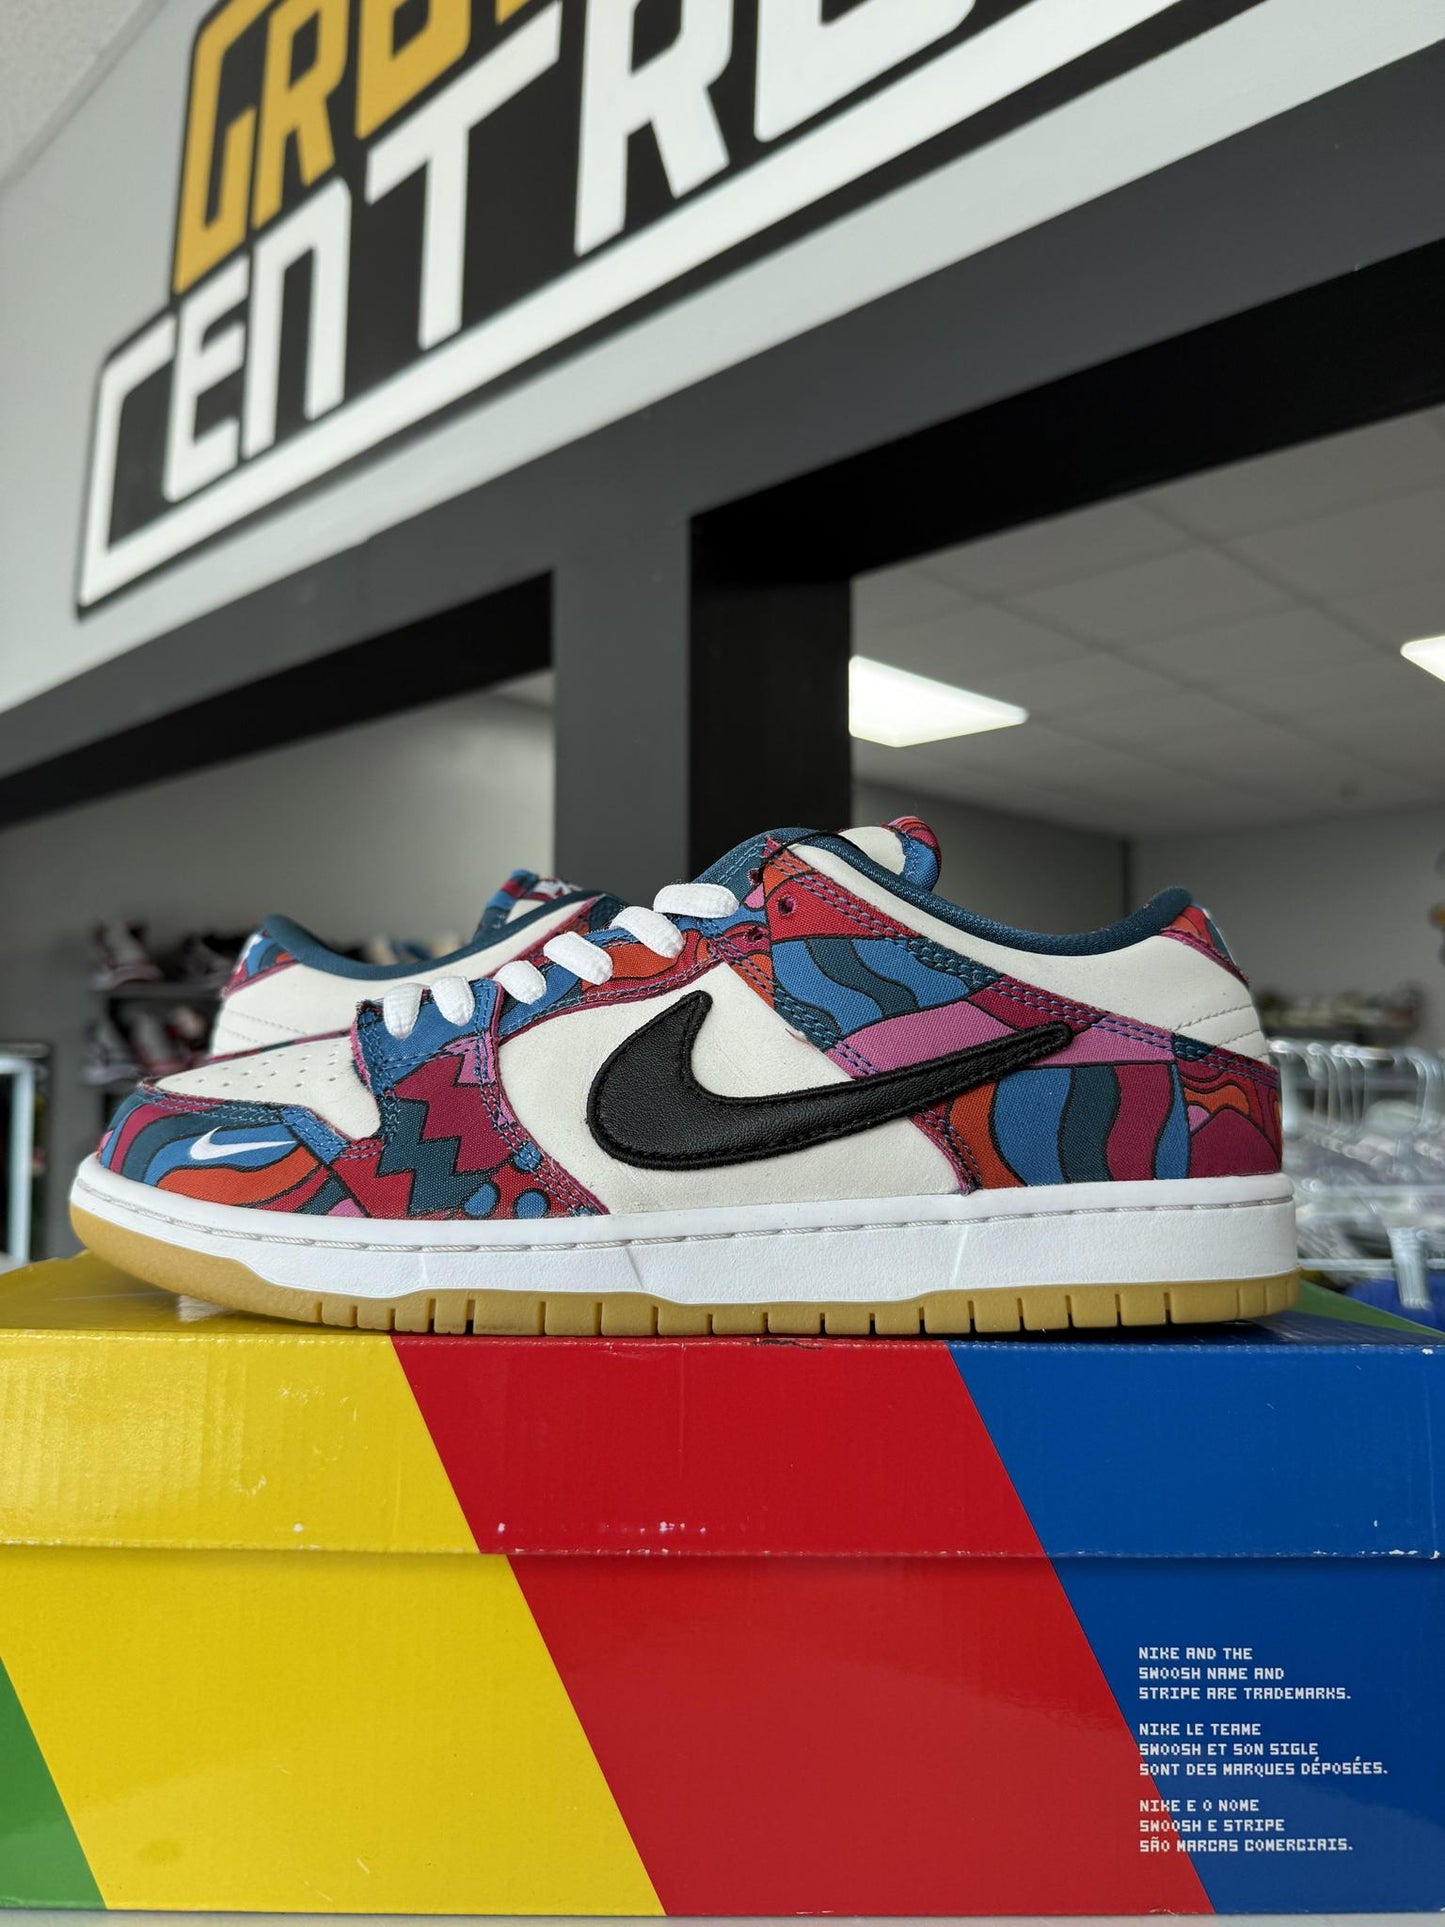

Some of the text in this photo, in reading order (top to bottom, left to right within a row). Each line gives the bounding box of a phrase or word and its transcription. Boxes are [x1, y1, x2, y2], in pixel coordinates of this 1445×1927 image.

[1138, 1646, 1253, 1660] NIKE AND THE
[1138, 1666, 1285, 1680] SWOOSH NAME AND
[1139, 1686, 1351, 1700] STRIPE ARE TRADEMARKS.
[1139, 1723, 1181, 1736] NIKE
[1186, 1723, 1204, 1736] LE
[1139, 1742, 1319, 1756] SWOOSH ET SON SIGLE
[1139, 1755, 1388, 1778] SONT DES MARQUES DÉPOSÉES.
[1139, 1799, 1260, 1812] NIKE E O NOME
[1139, 1818, 1285, 1833] SWOOSH E STRIPE
[1139, 1836, 1353, 1853] SÃO MARCAS COMERCIAIS.
